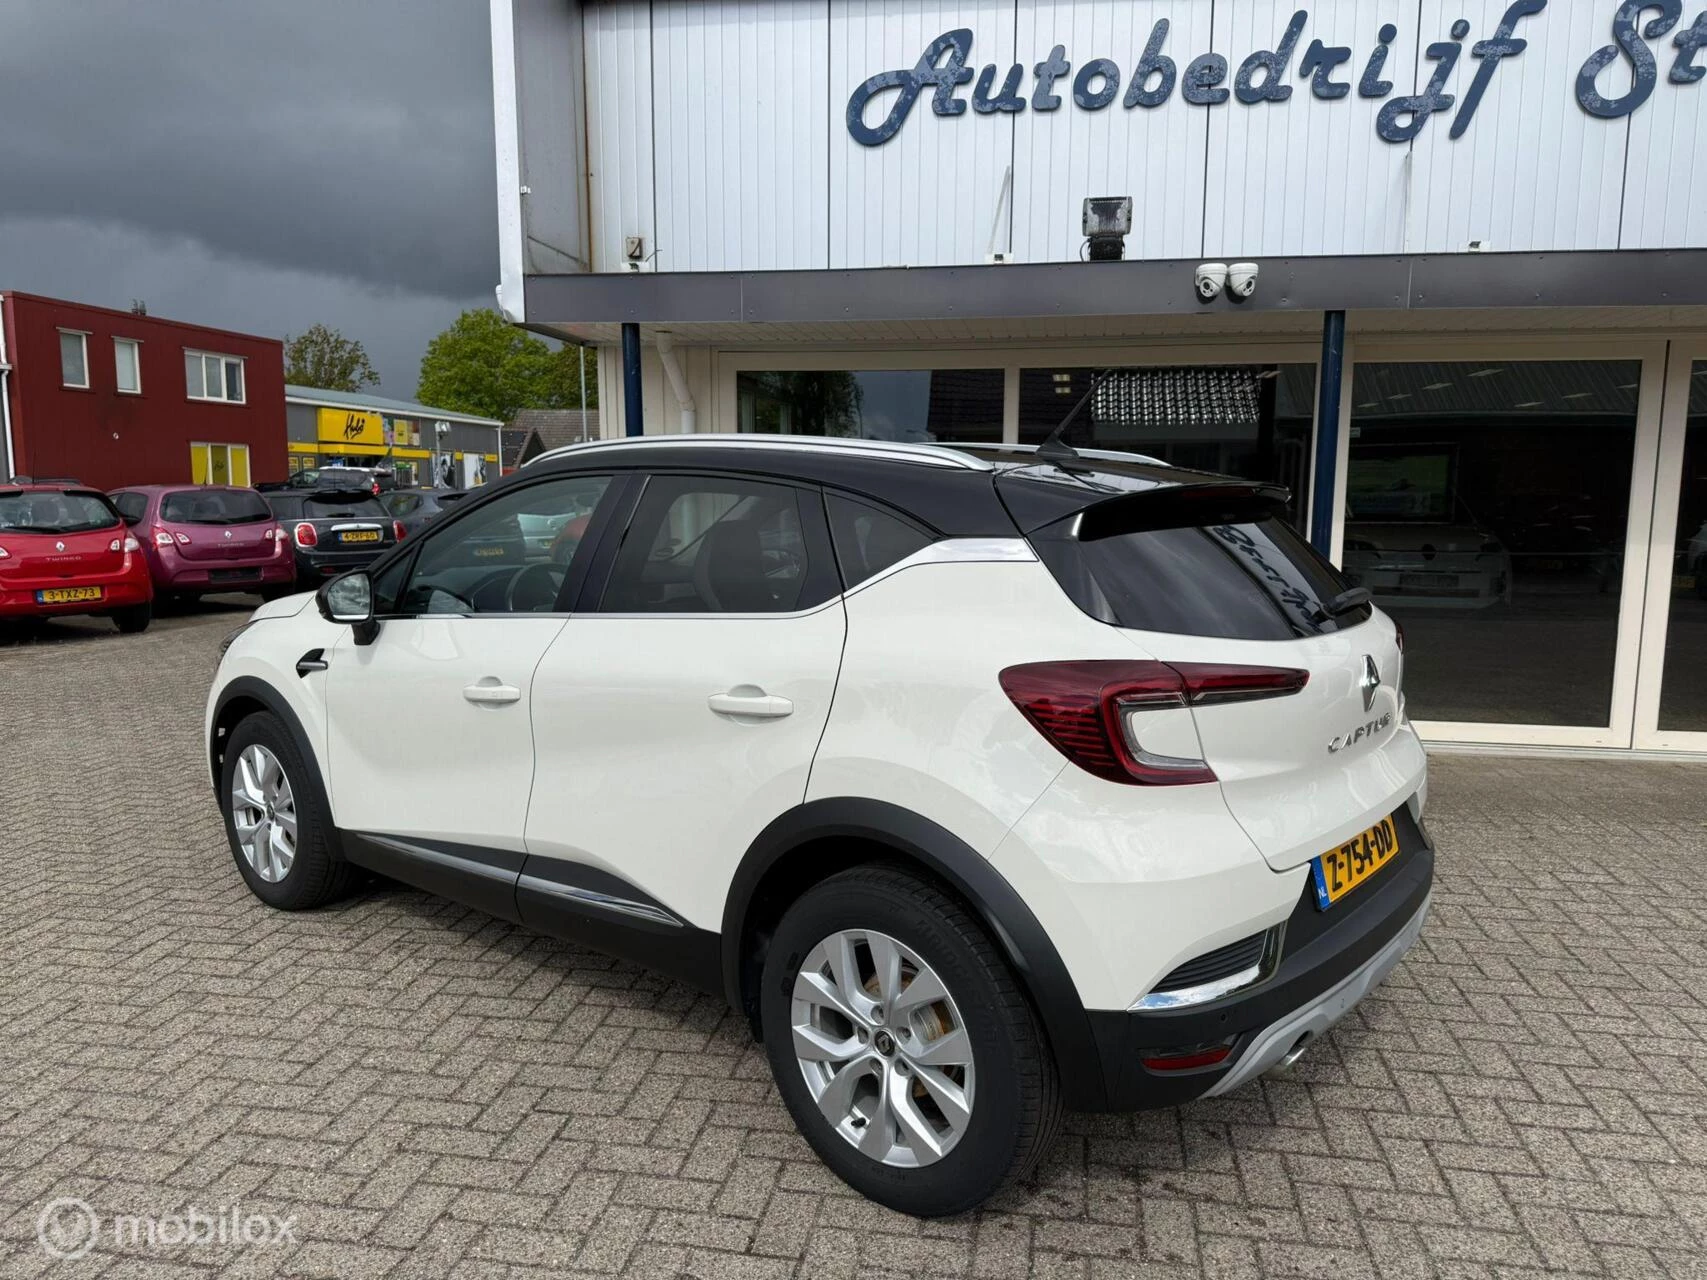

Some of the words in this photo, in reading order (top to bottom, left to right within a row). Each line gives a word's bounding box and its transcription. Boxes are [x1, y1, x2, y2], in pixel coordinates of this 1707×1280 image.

[846, 0, 1548, 147] Autobedrijf
[48, 587, 96, 600] 3-TXZ-73
[1326, 818, 1394, 893] Z-754-DD
